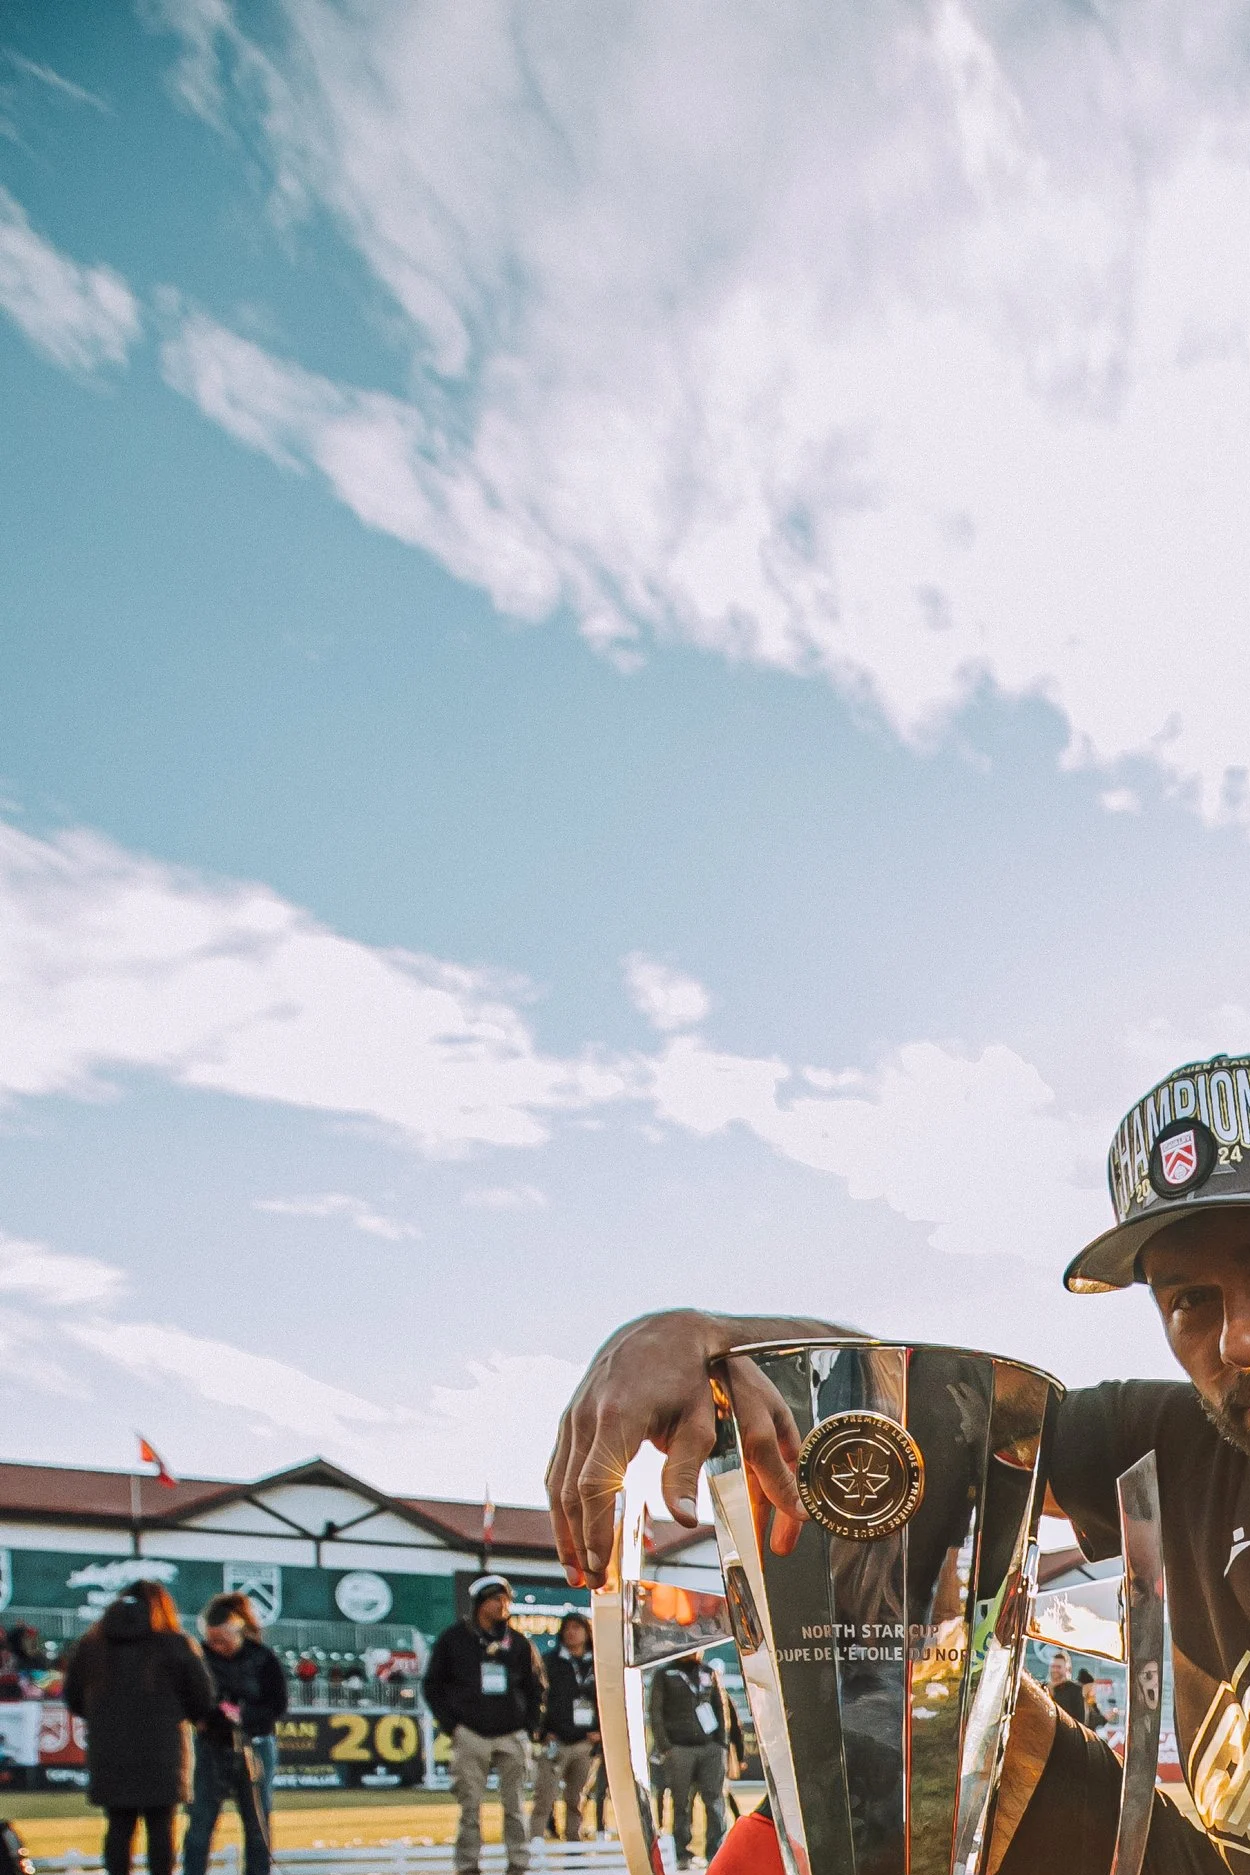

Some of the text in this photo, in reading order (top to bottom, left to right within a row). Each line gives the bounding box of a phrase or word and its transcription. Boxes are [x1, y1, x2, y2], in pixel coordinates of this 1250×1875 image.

[1218, 1146, 1243, 1165] 24
[799, 1415, 919, 1469] CANADIAN PREMIER LEAGUE
[799, 1480, 850, 1536] CANADIENNE
[853, 1524, 887, 1538] LIGUE
[801, 1624, 938, 1640] NORTH STAR CUP
[814, 1647, 832, 1661] DE
[909, 1648, 931, 1661] DU
